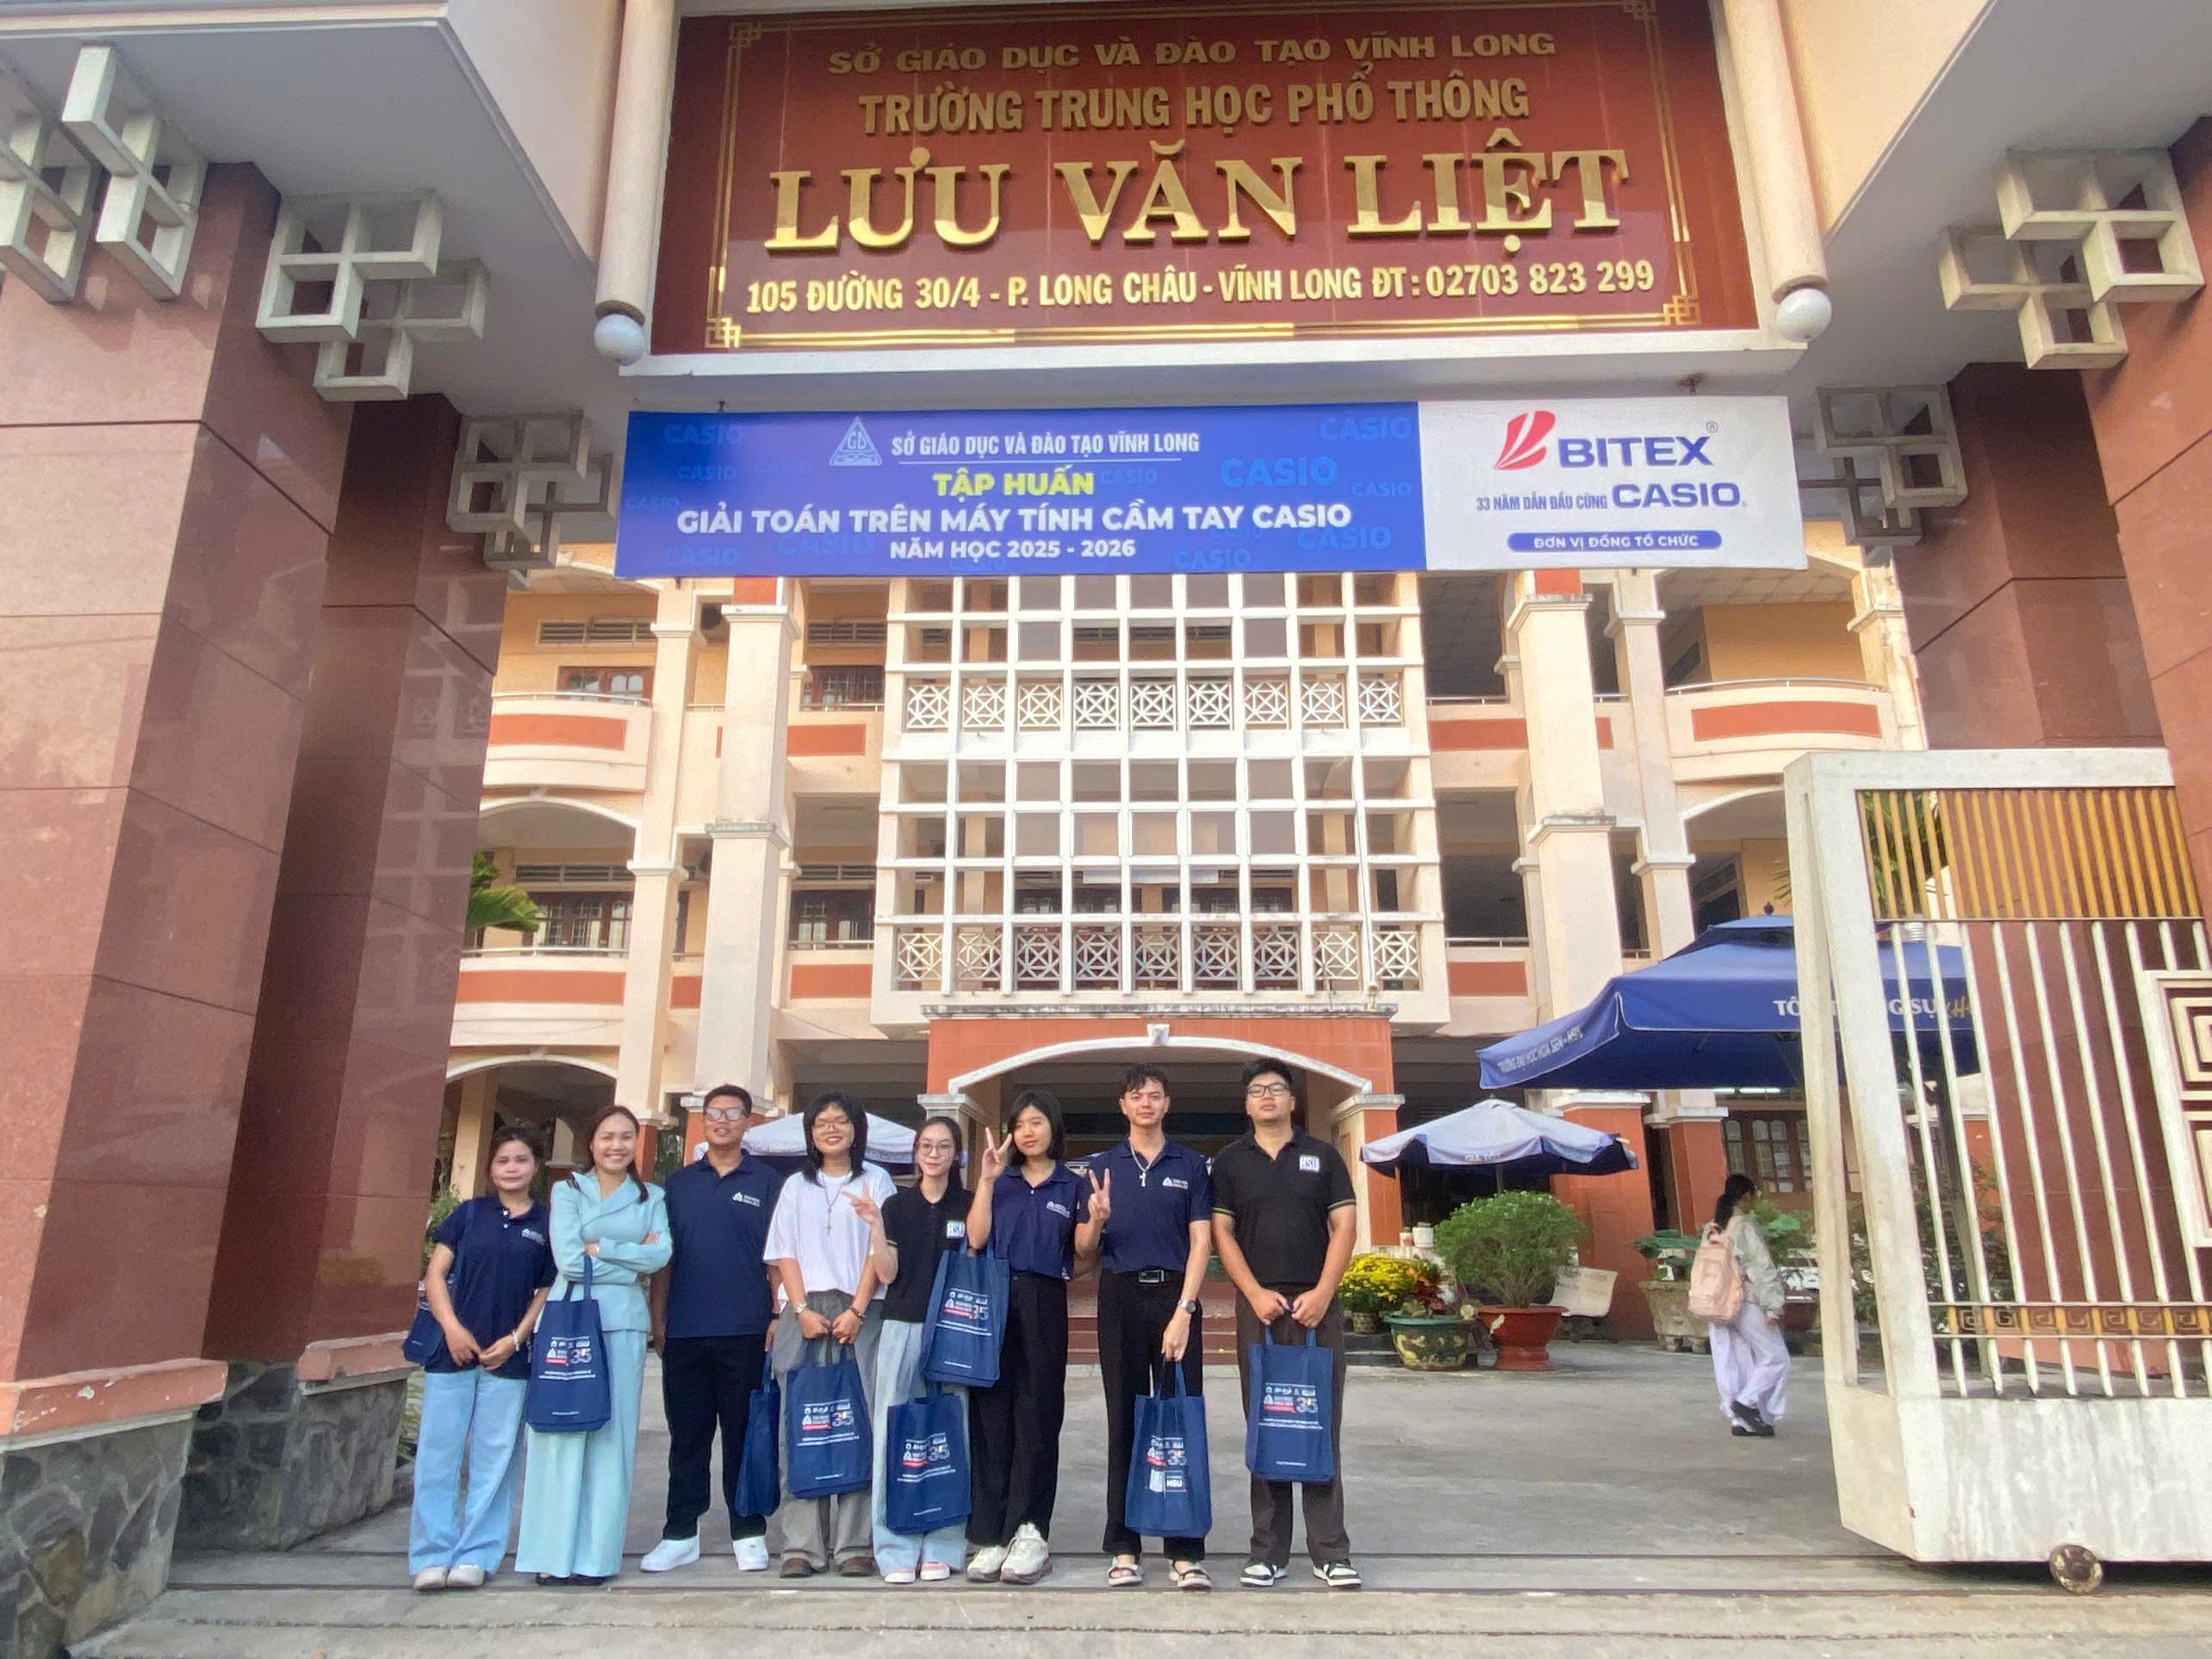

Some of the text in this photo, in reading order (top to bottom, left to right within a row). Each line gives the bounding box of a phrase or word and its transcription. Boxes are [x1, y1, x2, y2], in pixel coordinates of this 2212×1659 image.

[828, 30, 1556, 75] SỞ GIÁO DỤC VÀ ĐÀO TẠO VĨNH LONG
[859, 60, 1531, 136] TRƯỜNG TRUNG HỌC PHỔ THÔNG
[764, 128, 1629, 257] LƯU VĂN LIỆT
[747, 281, 798, 313] 105
[806, 270, 903, 311] ĐƯỜNG
[915, 276, 980, 308] 30/4
[990, 289, 999, 301] -
[1008, 276, 1028, 307] P.
[1039, 273, 1113, 307] LONG
[1123, 264, 1197, 303] CHÂU
[1218, 264, 1282, 302] VĨNH
[1290, 267, 1362, 301] LONG
[1426, 263, 1519, 296] 02703
[1529, 262, 1587, 294] 823
[1596, 260, 1655, 292] 299
[1320, 415, 1412, 442] CASIO
[892, 429, 1200, 459] SỞ GIÁO DỤC VÀ ĐÀO TẠO VĨNH LONG
[1557, 436, 1713, 469] BITEX
[932, 463, 1094, 503] TẬP HUẤN
[1221, 456, 1338, 488] CASIO
[1351, 482, 1412, 497] CASIO
[1476, 497, 1490, 511] 33
[1494, 494, 1520, 511] NĂM
[1612, 482, 1741, 508] CASIO
[676, 498, 1351, 534] GIẢI TOÁN TRÊN MÁY TÍNH CẦM TAY CASIO
[890, 537, 944, 560] NĂM
[950, 541, 1001, 563] HỌC
[1007, 540, 1060, 558] 2025
[1081, 539, 1136, 558] 2026
[1533, 536, 1566, 549] ĐƠN
[1569, 536, 1584, 551] VỊ
[1658, 533, 1699, 547] CHỨC
[1174, 548, 1252, 569] CASIO
[1300, 1155, 1320, 1171] HSU
[570, 1348, 592, 1364] 35
